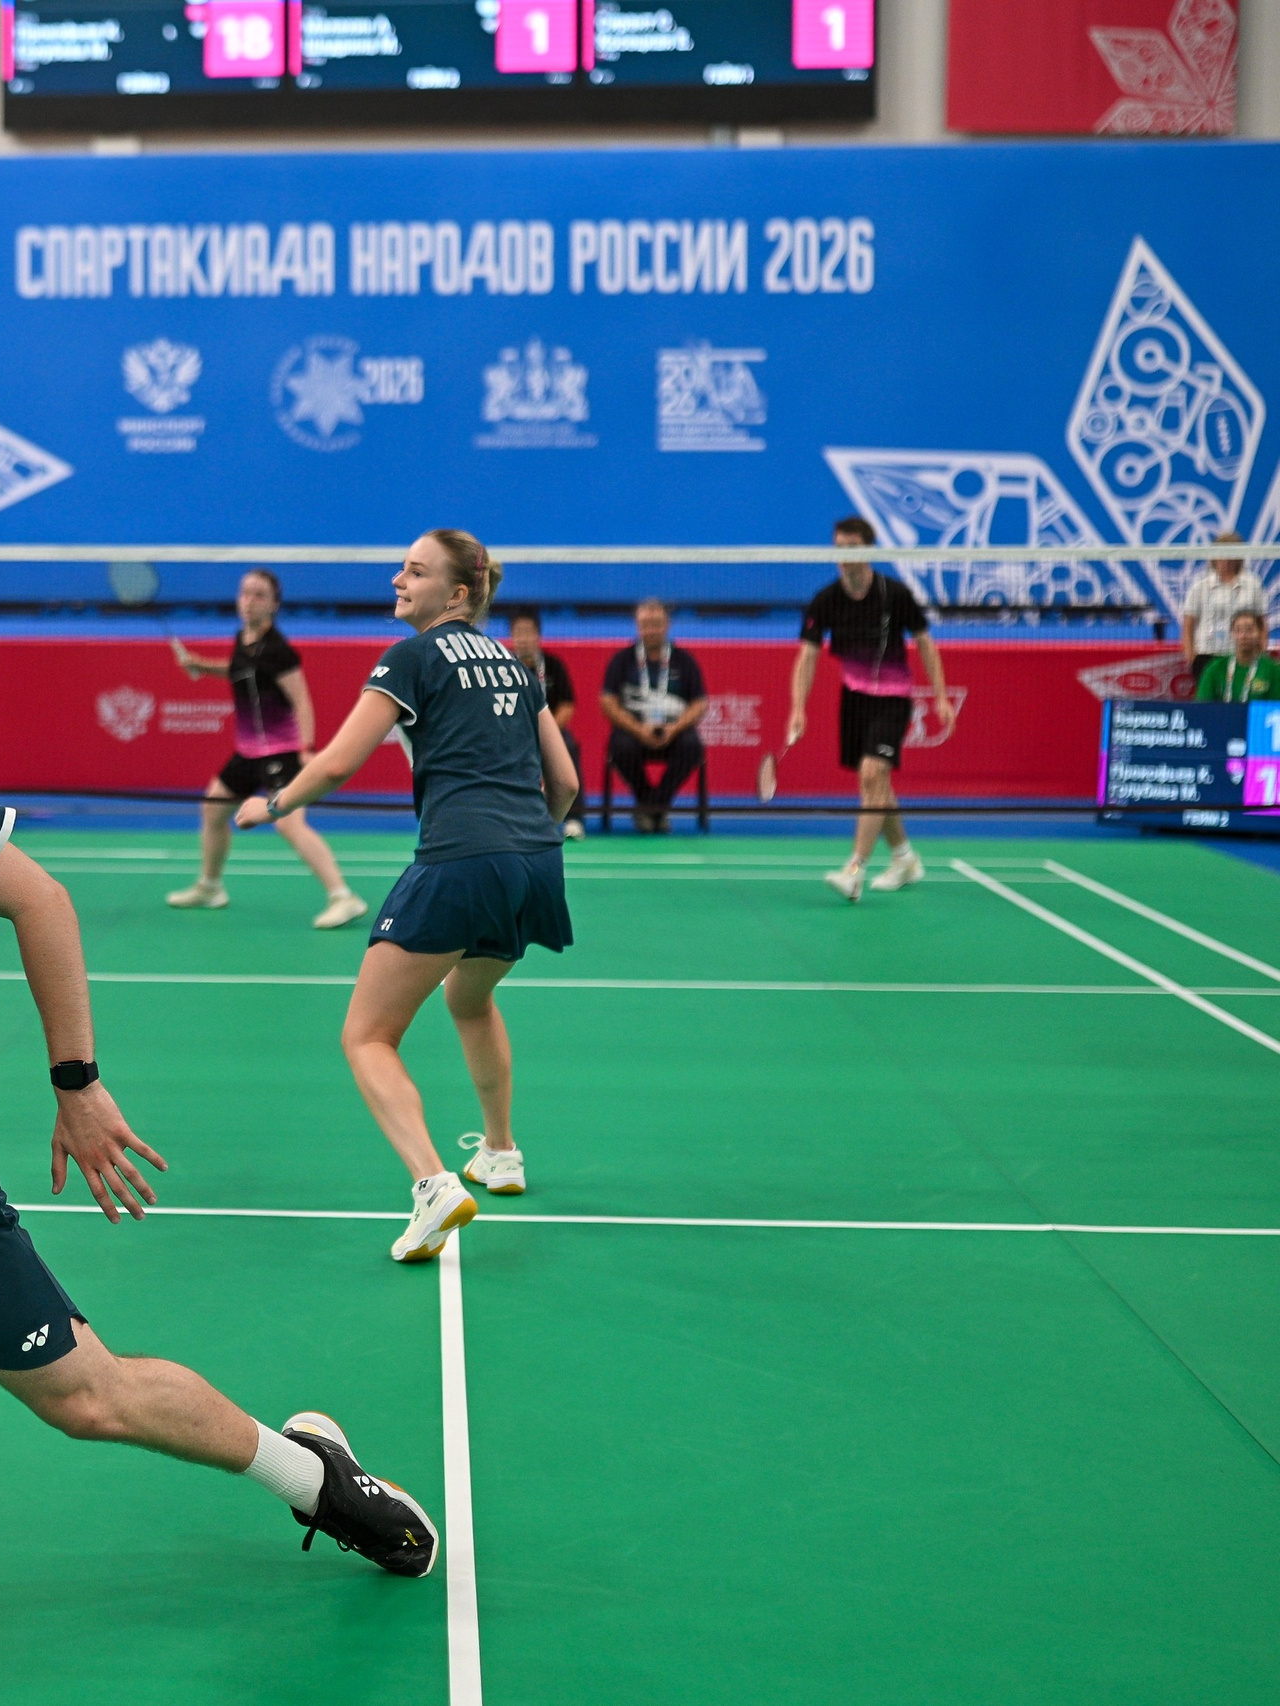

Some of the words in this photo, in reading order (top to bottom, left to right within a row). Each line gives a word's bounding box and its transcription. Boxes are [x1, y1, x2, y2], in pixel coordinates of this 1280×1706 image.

[215, 14, 275, 61] 18
[525, 10, 549, 55] 1
[822, 6, 846, 51] 1
[15, 222, 337, 298] СПАРТАКИАДА
[349, 220, 555, 296] НАРОДОВ
[569, 218, 749, 295] РОССИИ
[763, 217, 876, 294] 2026
[360, 356, 425, 404] 2026
